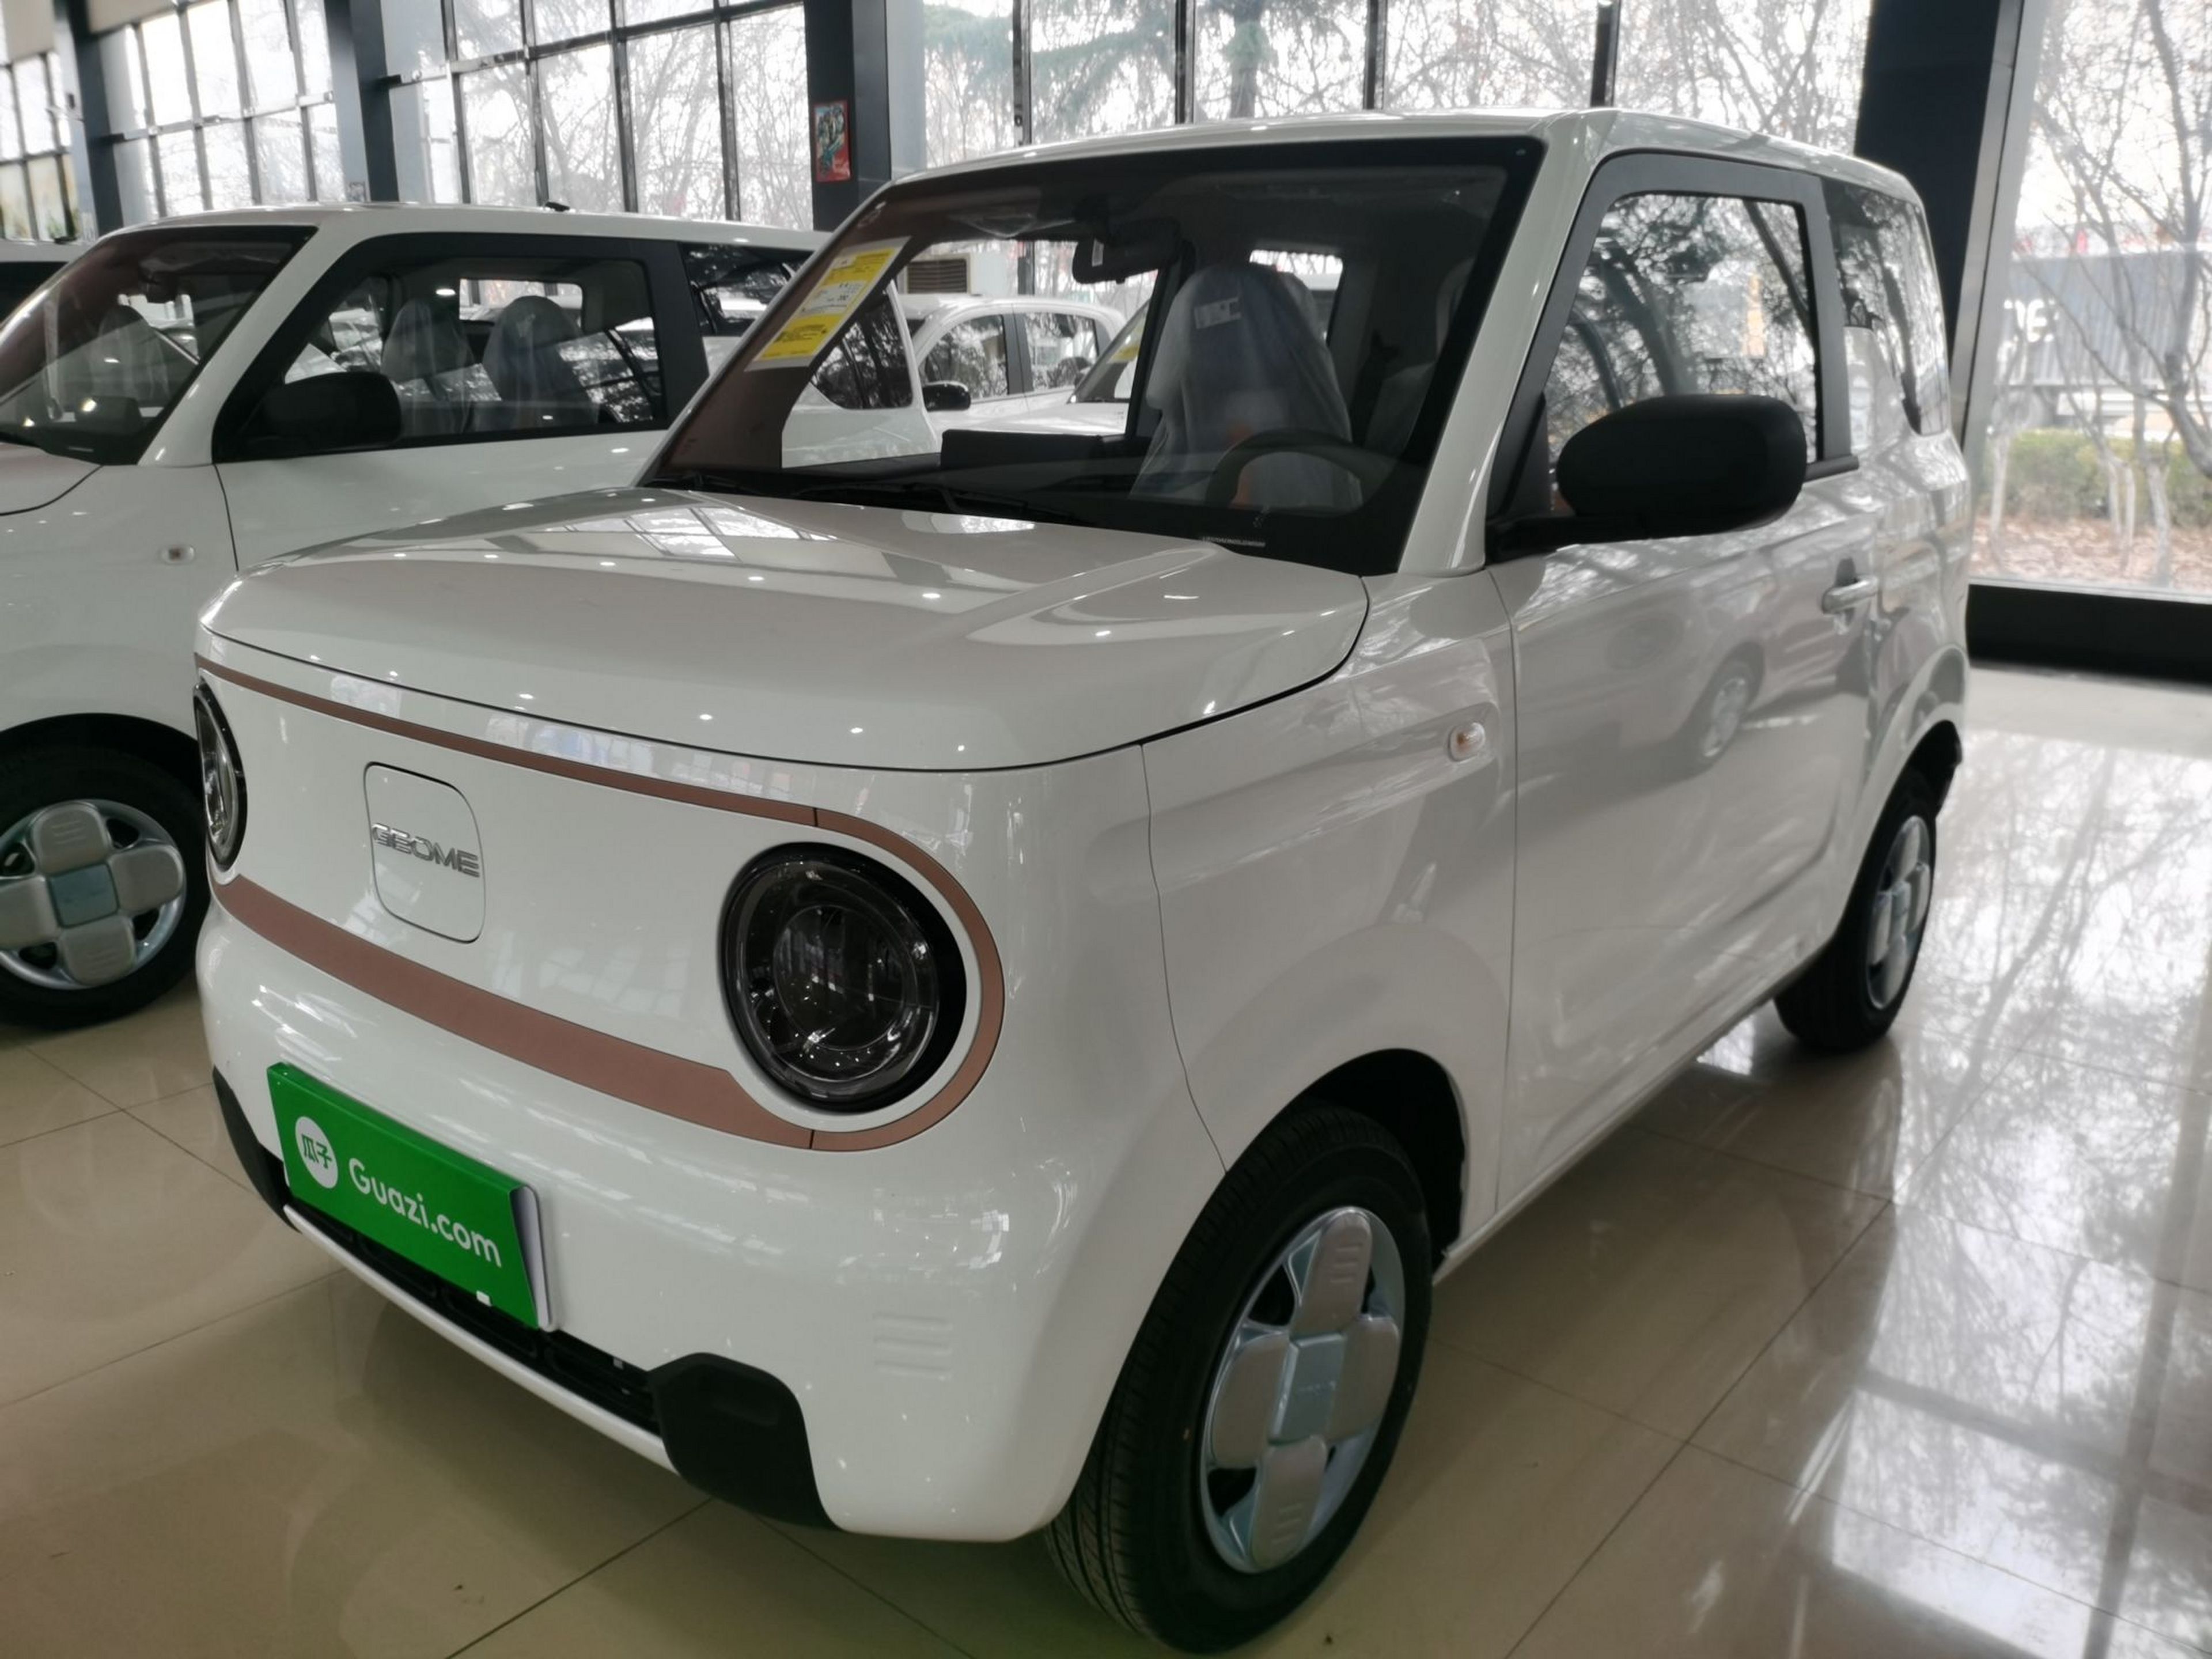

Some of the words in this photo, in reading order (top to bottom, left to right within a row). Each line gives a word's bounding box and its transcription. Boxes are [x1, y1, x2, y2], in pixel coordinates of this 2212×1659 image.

[372, 823, 480, 878] GEOME
[301, 1133, 332, 1169] 瓜子
[349, 1157, 502, 1268] Guazi.com
